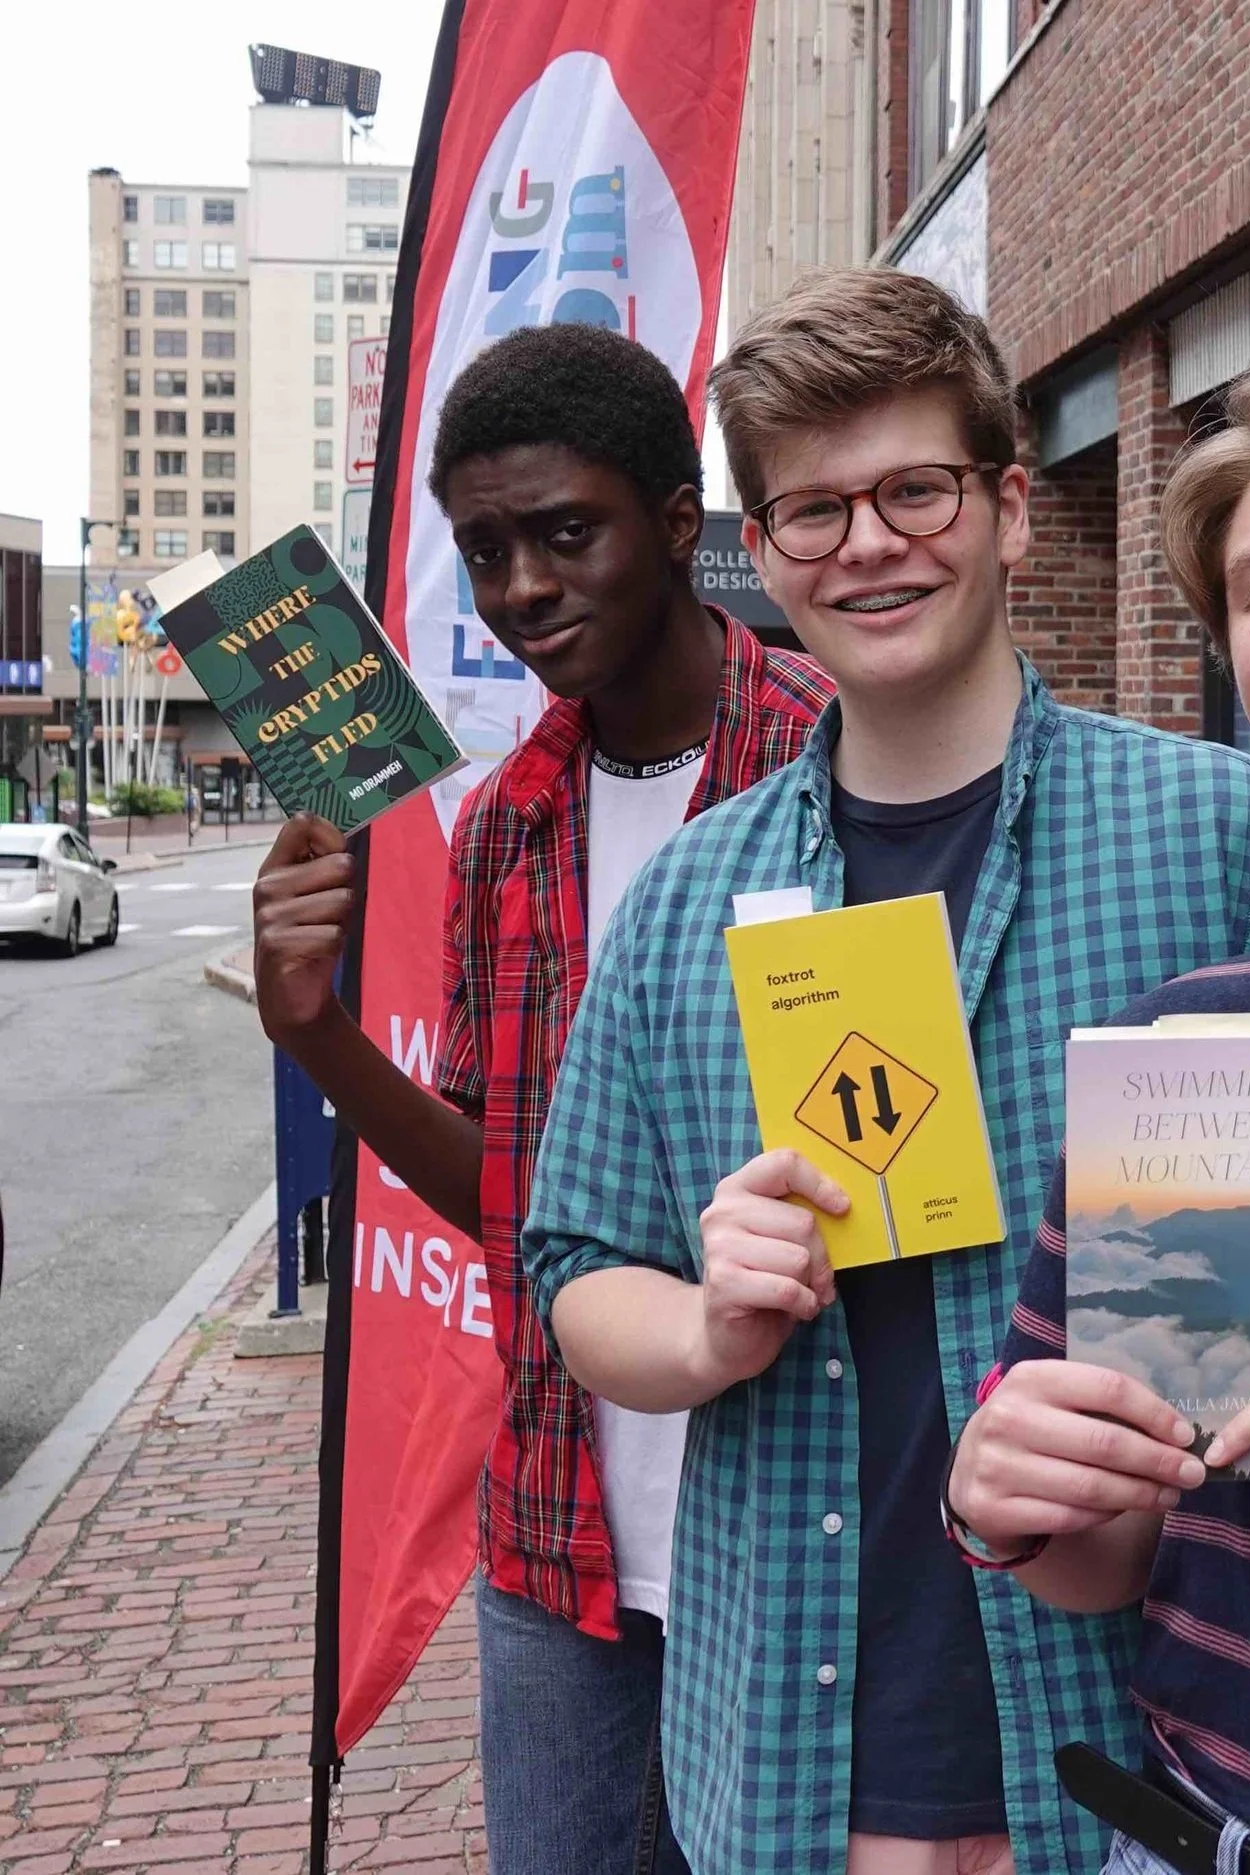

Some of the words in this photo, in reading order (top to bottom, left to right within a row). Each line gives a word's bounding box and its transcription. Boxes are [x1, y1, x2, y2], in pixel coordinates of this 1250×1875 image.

[350, 383, 380, 410] PARK
[362, 413, 378, 431] AN
[704, 571, 762, 590] DESIG
[217, 584, 317, 656] WHERE
[268, 640, 321, 681] THE
[257, 652, 382, 744] CRYPTIDS
[311, 711, 379, 765] FLED
[349, 786, 365, 800] MO
[362, 760, 403, 792] DRAMMEH
[766, 968, 815, 987] foxtrot
[771, 988, 840, 1012] algorithm
[923, 1196, 957, 1208] atticus
[925, 1210, 952, 1223] prinn
